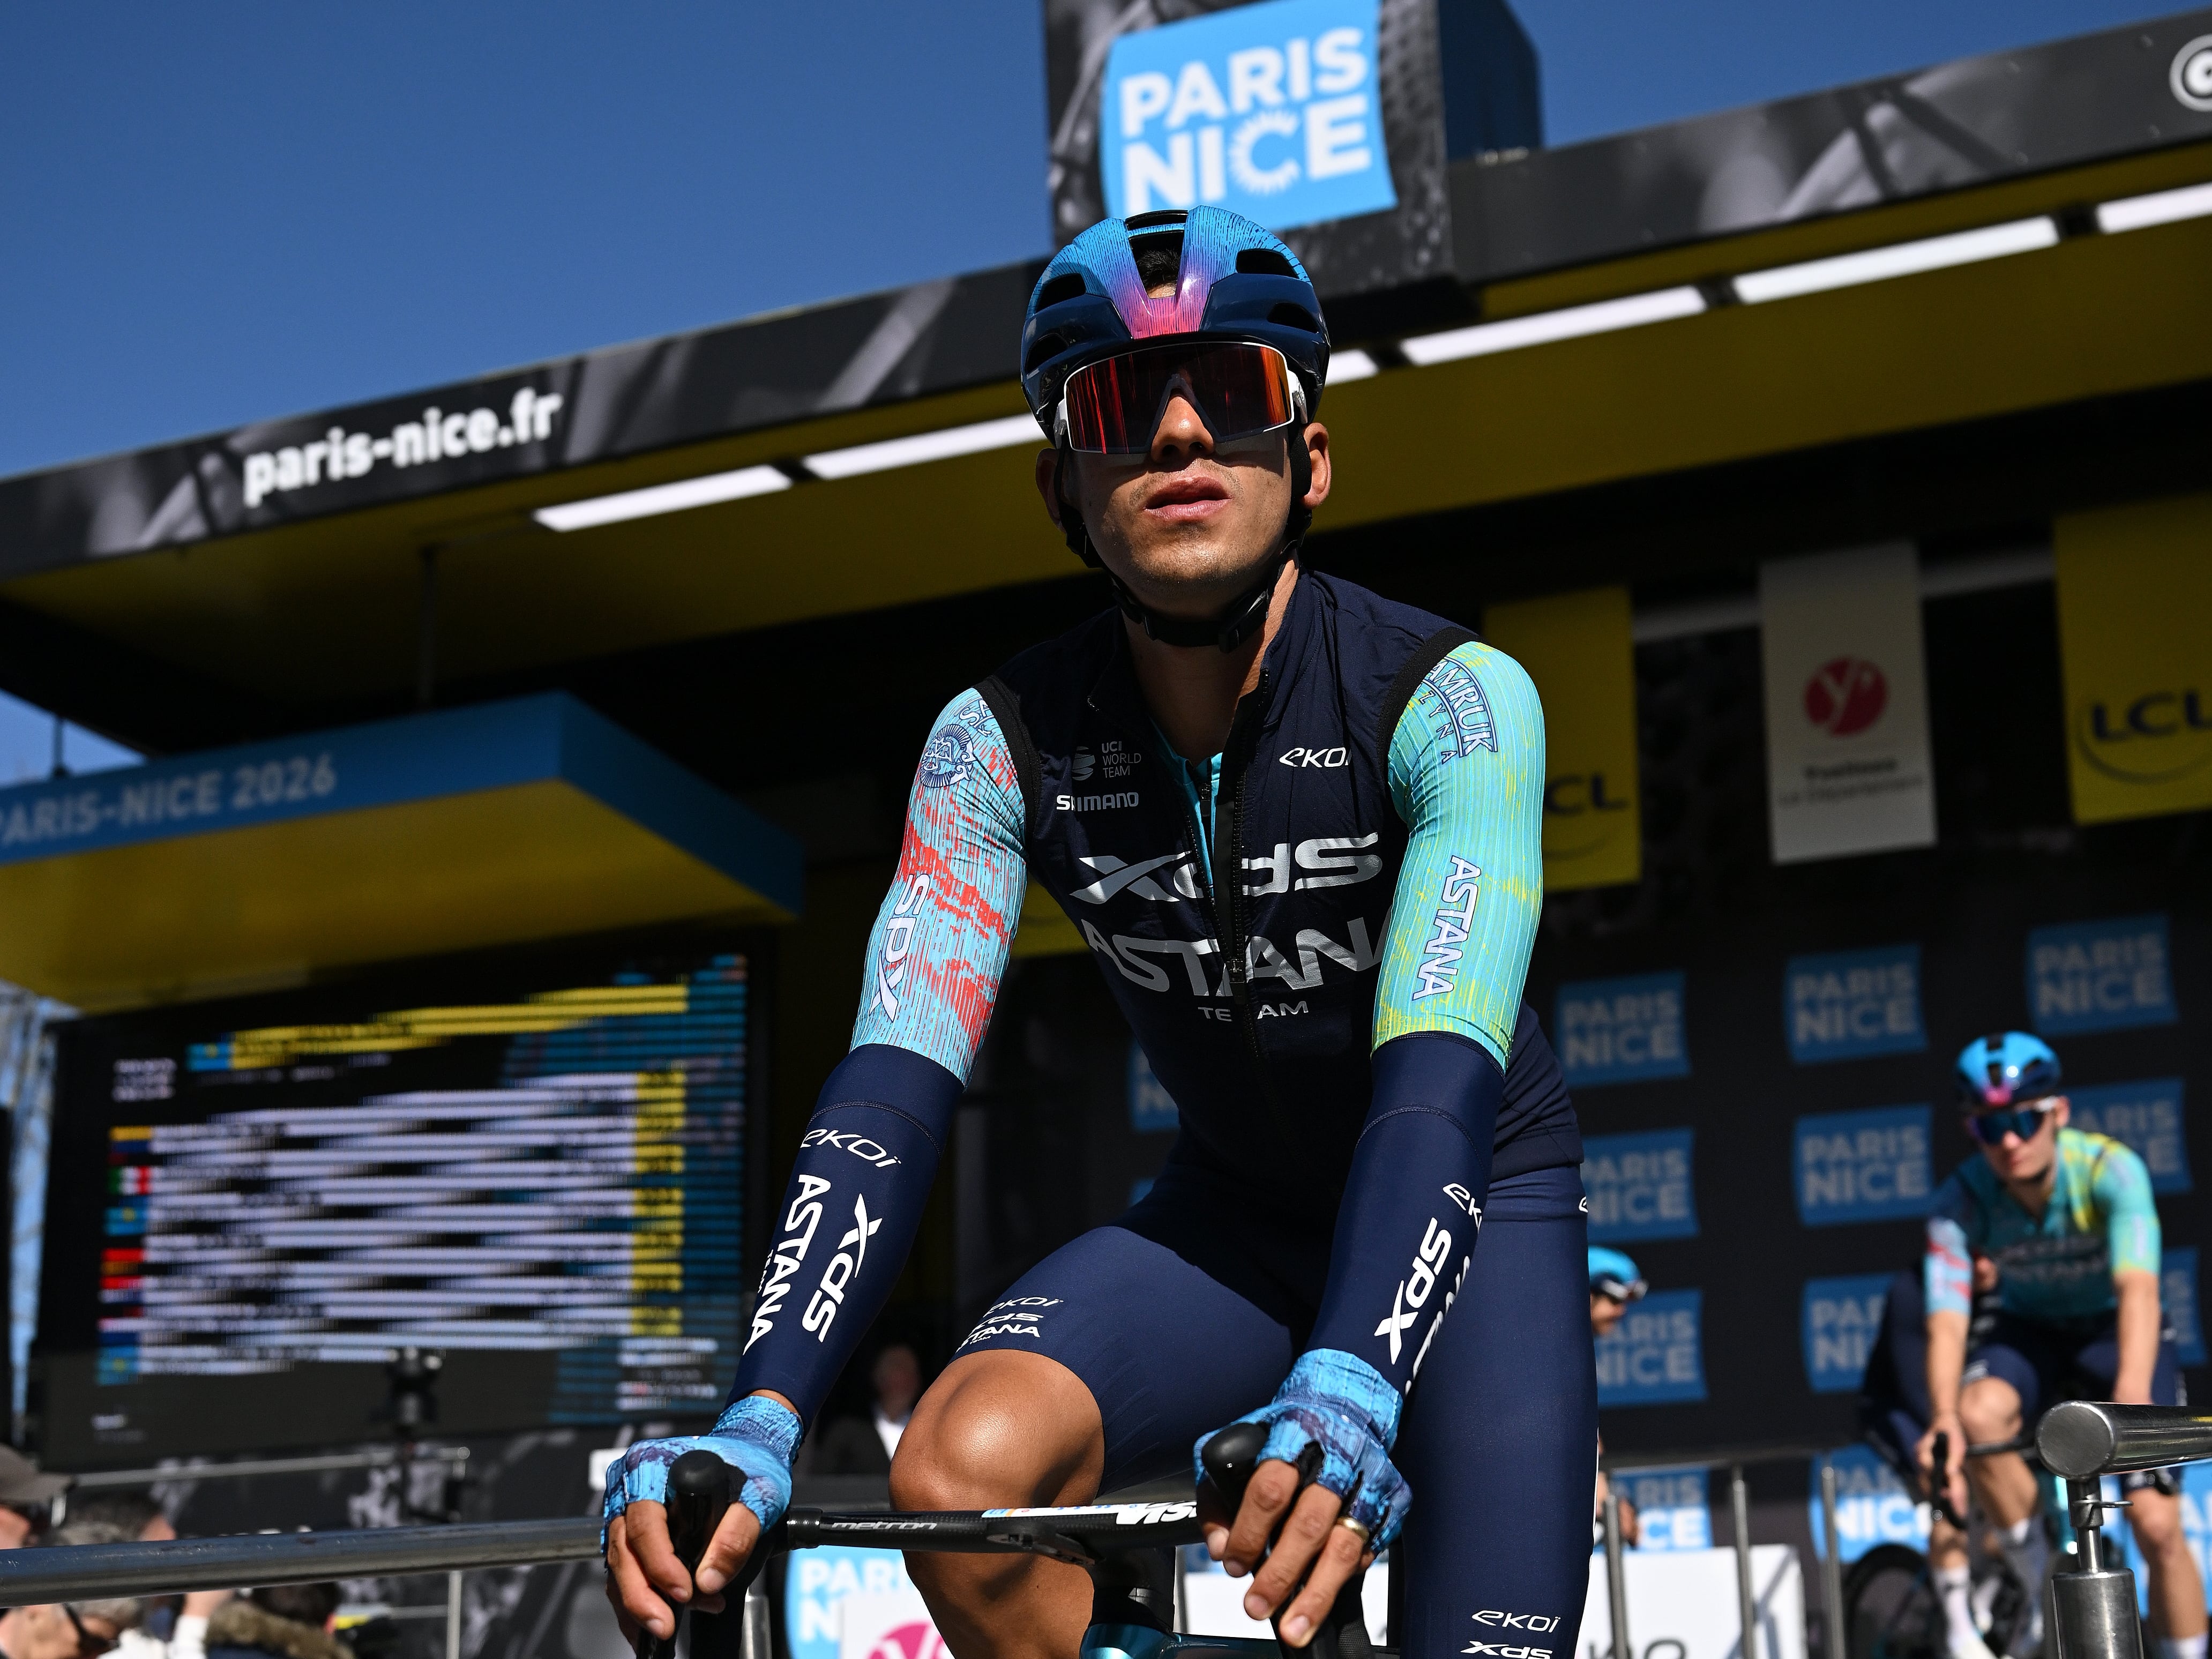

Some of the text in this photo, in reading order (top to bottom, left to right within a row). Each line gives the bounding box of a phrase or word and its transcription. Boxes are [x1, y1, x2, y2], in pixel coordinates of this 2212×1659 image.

[1120, 27, 1367, 138] PARIS
[1122, 94, 1372, 216] NICE
[244, 387, 562, 506] paris-nice.fr
[1413, 682, 1458, 765] ZYNA
[1428, 660, 1493, 756] AMRUK
[1102, 741, 1122, 753] UCI
[1102, 753, 1141, 766] WORLD
[1102, 765, 1130, 779] TEAM
[1543, 774, 1628, 814] CL
[0, 753, 337, 848] ARIS-NICE 2026
[1413, 855, 1481, 1001] ASTANA
[2035, 933, 2164, 974] PARIS
[1793, 962, 1915, 1001] PARIS
[2037, 967, 2170, 1017] NICE
[1562, 990, 1679, 1029] PARIS
[1796, 996, 1918, 1043] NICE
[1565, 1022, 1682, 1067] NICE
[1802, 1125, 1926, 1163] PARIS
[1804, 1157, 1929, 1208] NICE
[743, 1174, 832, 1356] ASTANA
[831, 1521, 938, 1530] metron
[801, 1557, 912, 1592] PARI
